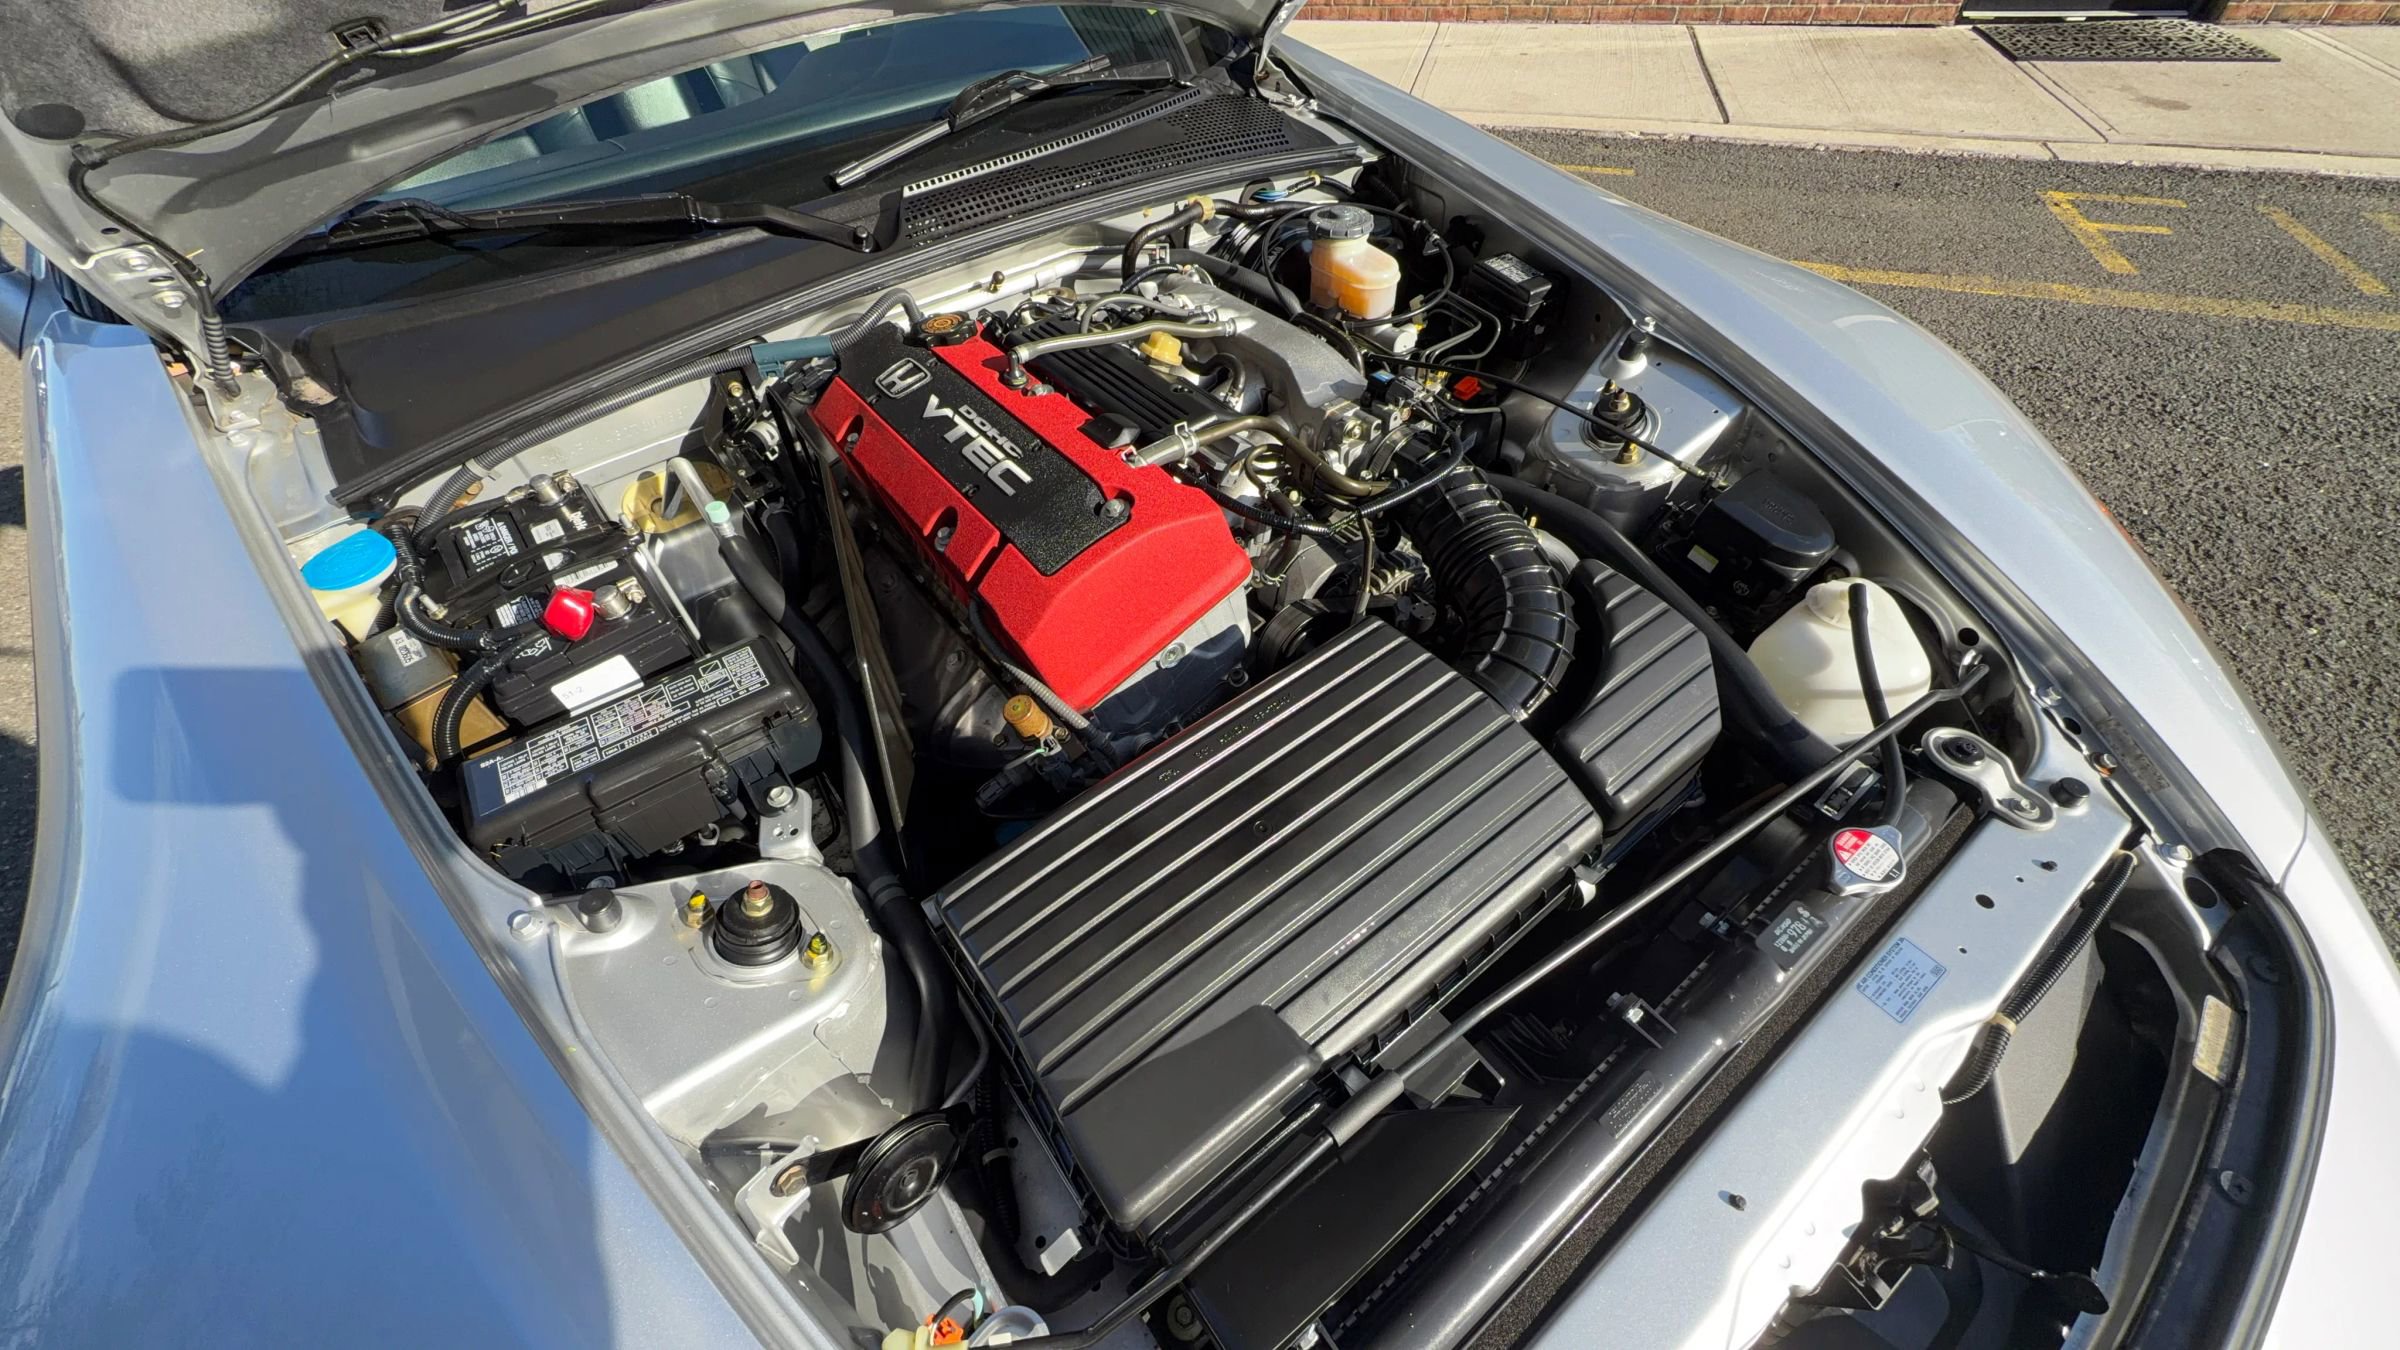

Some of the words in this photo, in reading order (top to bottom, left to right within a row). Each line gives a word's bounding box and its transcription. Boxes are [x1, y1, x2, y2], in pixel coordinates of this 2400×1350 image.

[922, 393, 1033, 497] VTEC
[959, 403, 1025, 460] DOHC
[1867, 955, 1888, 978] CONDITIONER
[1885, 941, 1900, 956] SYSTEM
